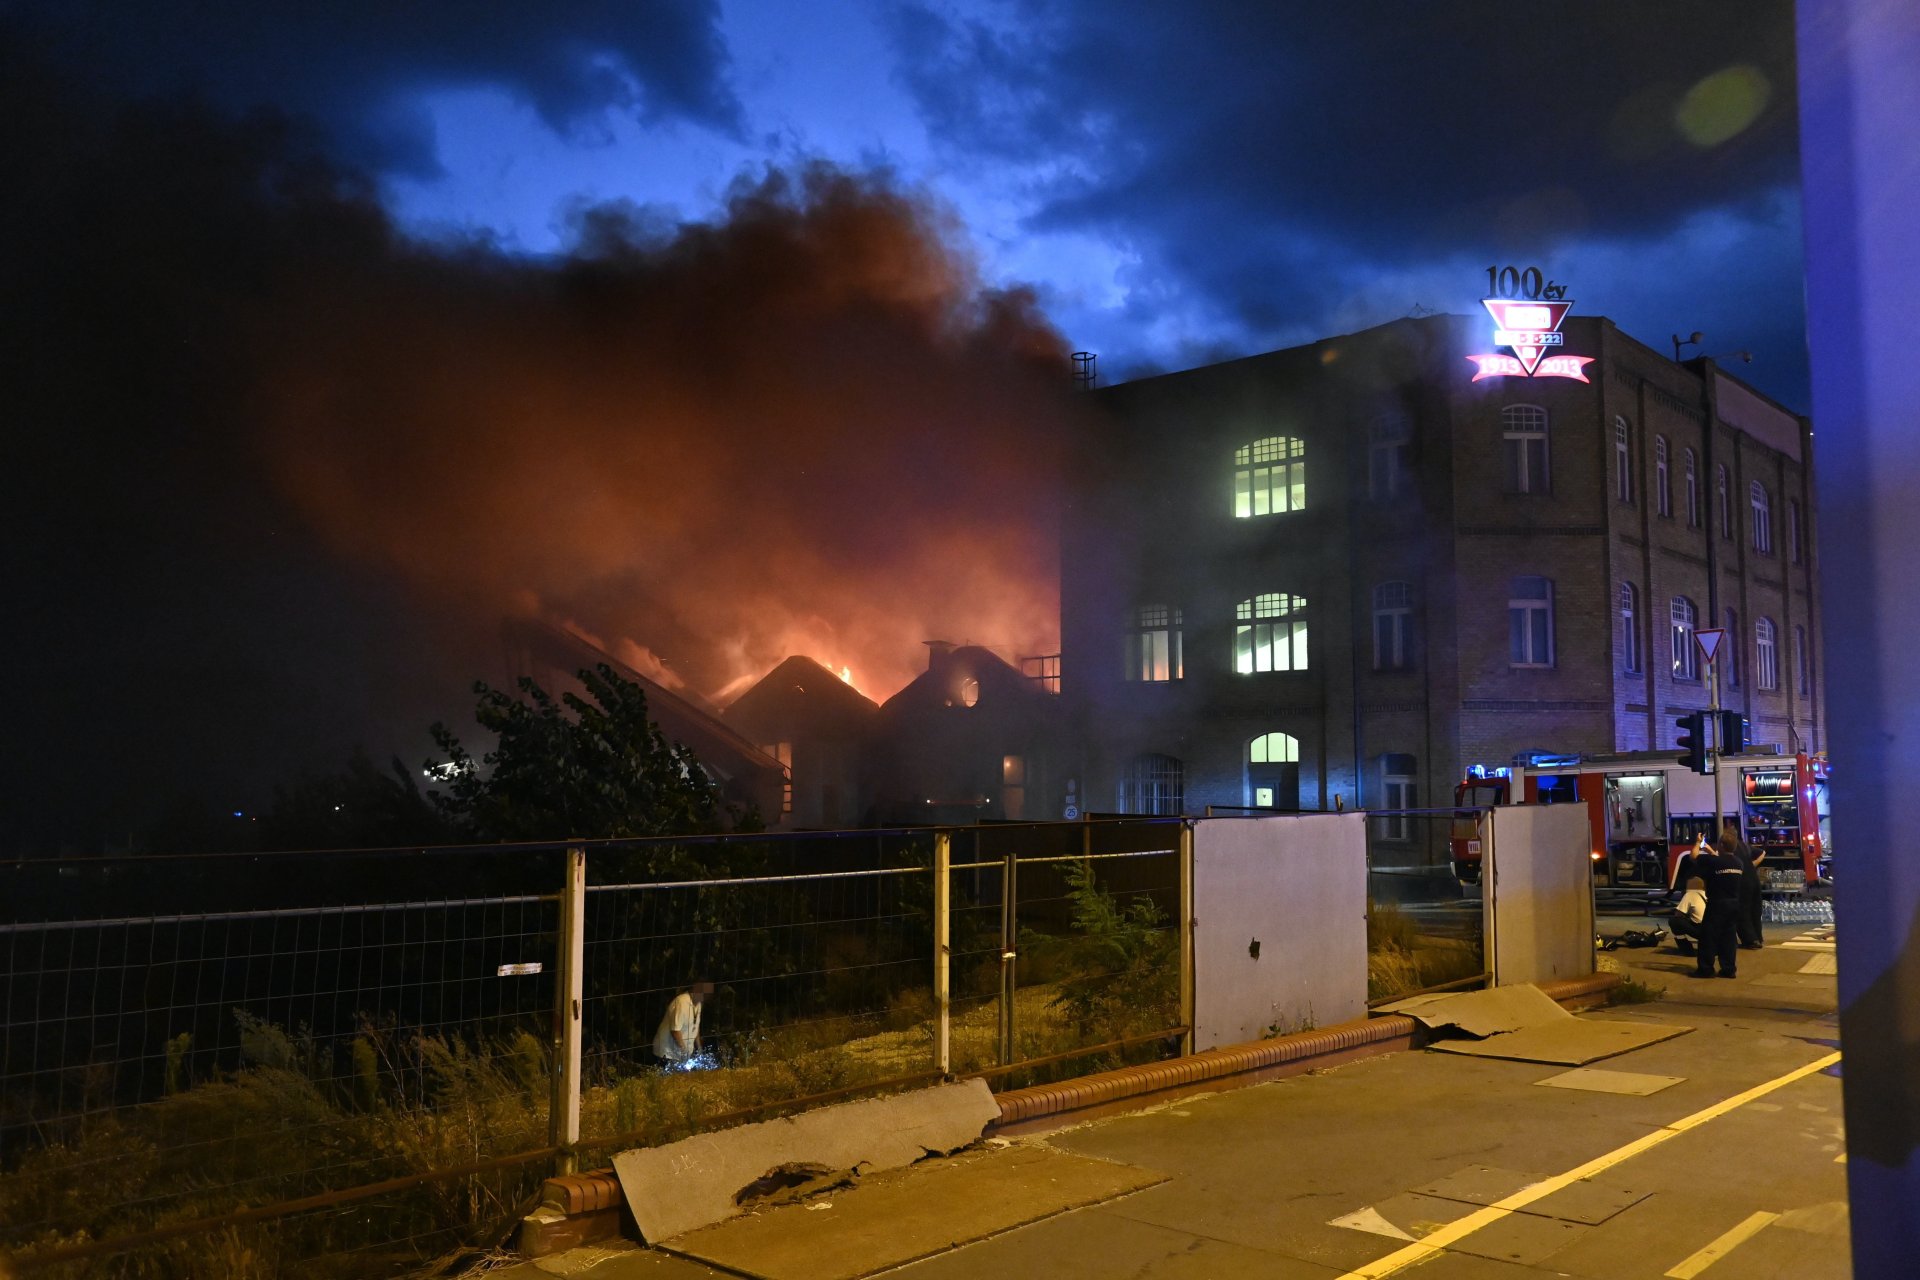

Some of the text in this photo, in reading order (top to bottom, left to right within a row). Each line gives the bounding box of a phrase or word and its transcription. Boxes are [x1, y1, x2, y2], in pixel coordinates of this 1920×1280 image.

[1486, 265, 1567, 299] 100 év
[1479, 359, 1520, 374] 1913
[1540, 359, 1581, 377] 2013
